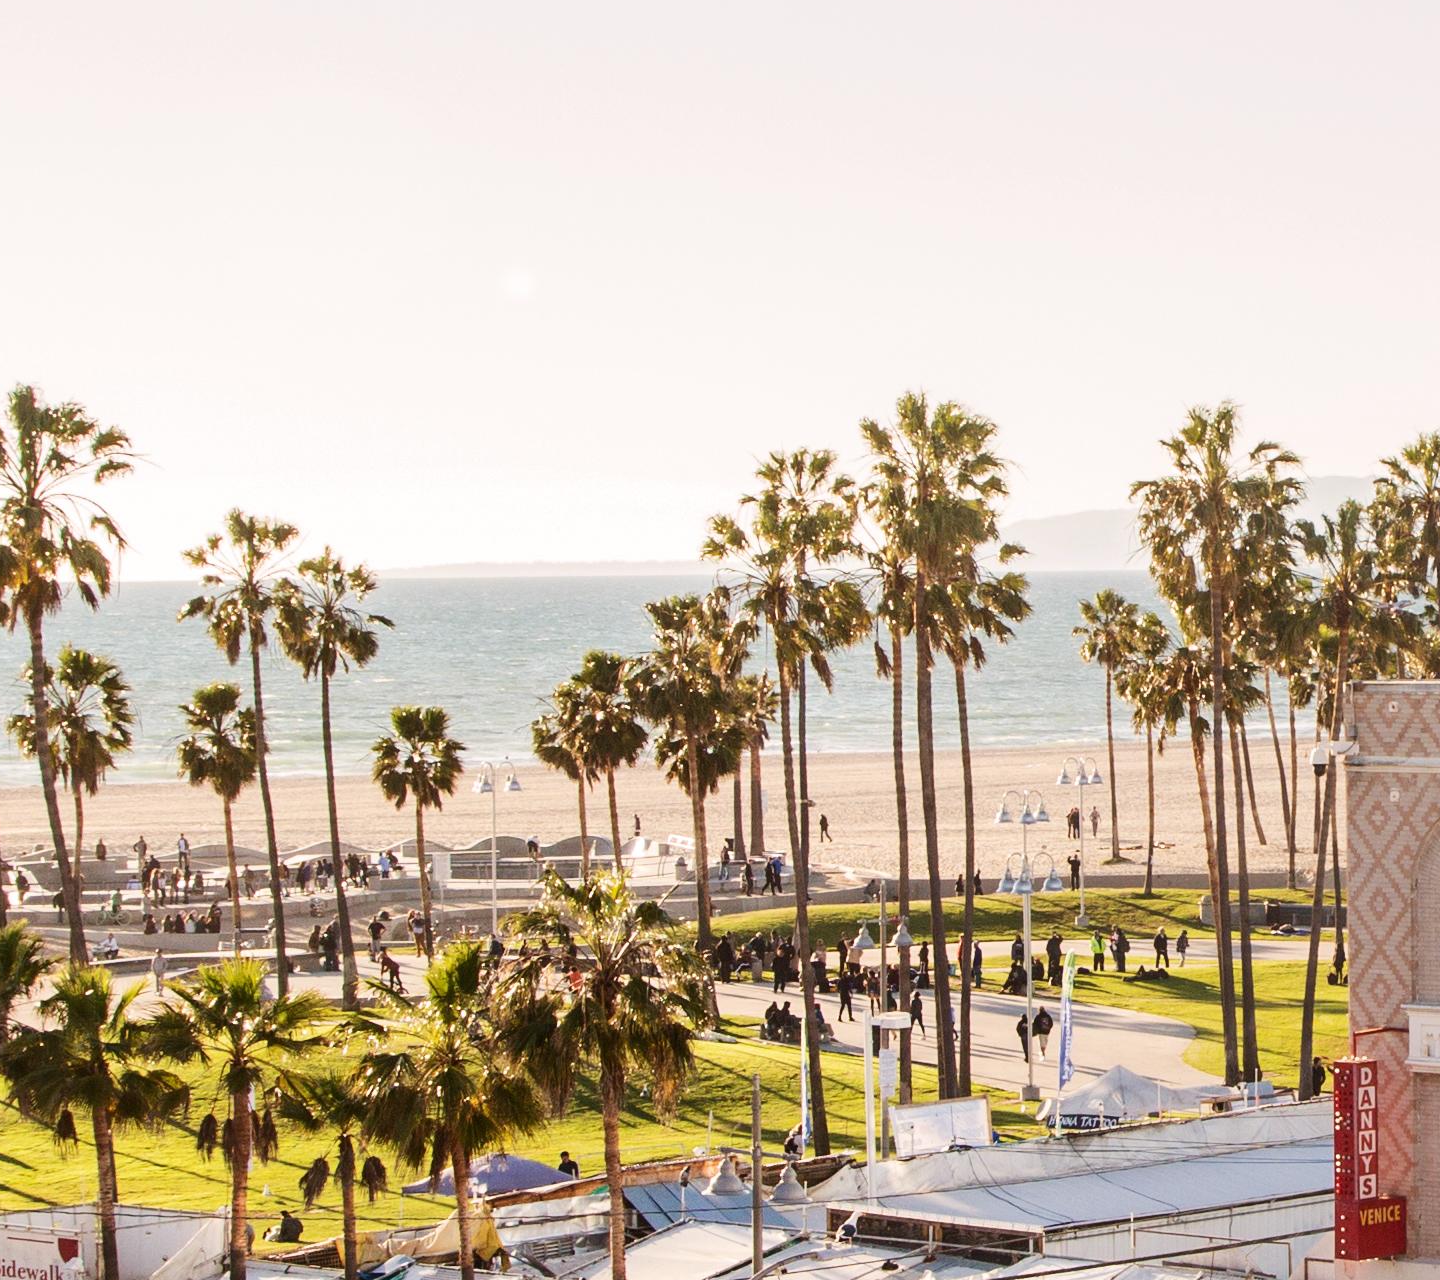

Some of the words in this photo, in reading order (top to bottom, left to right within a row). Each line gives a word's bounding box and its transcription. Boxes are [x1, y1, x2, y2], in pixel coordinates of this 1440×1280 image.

[1048, 1115, 1078, 1127] HNNA
[1079, 1115, 1117, 1128] TATOO
[1360, 1066, 1376, 1195] DANNYS
[1359, 1204, 1401, 1227] VENICE
